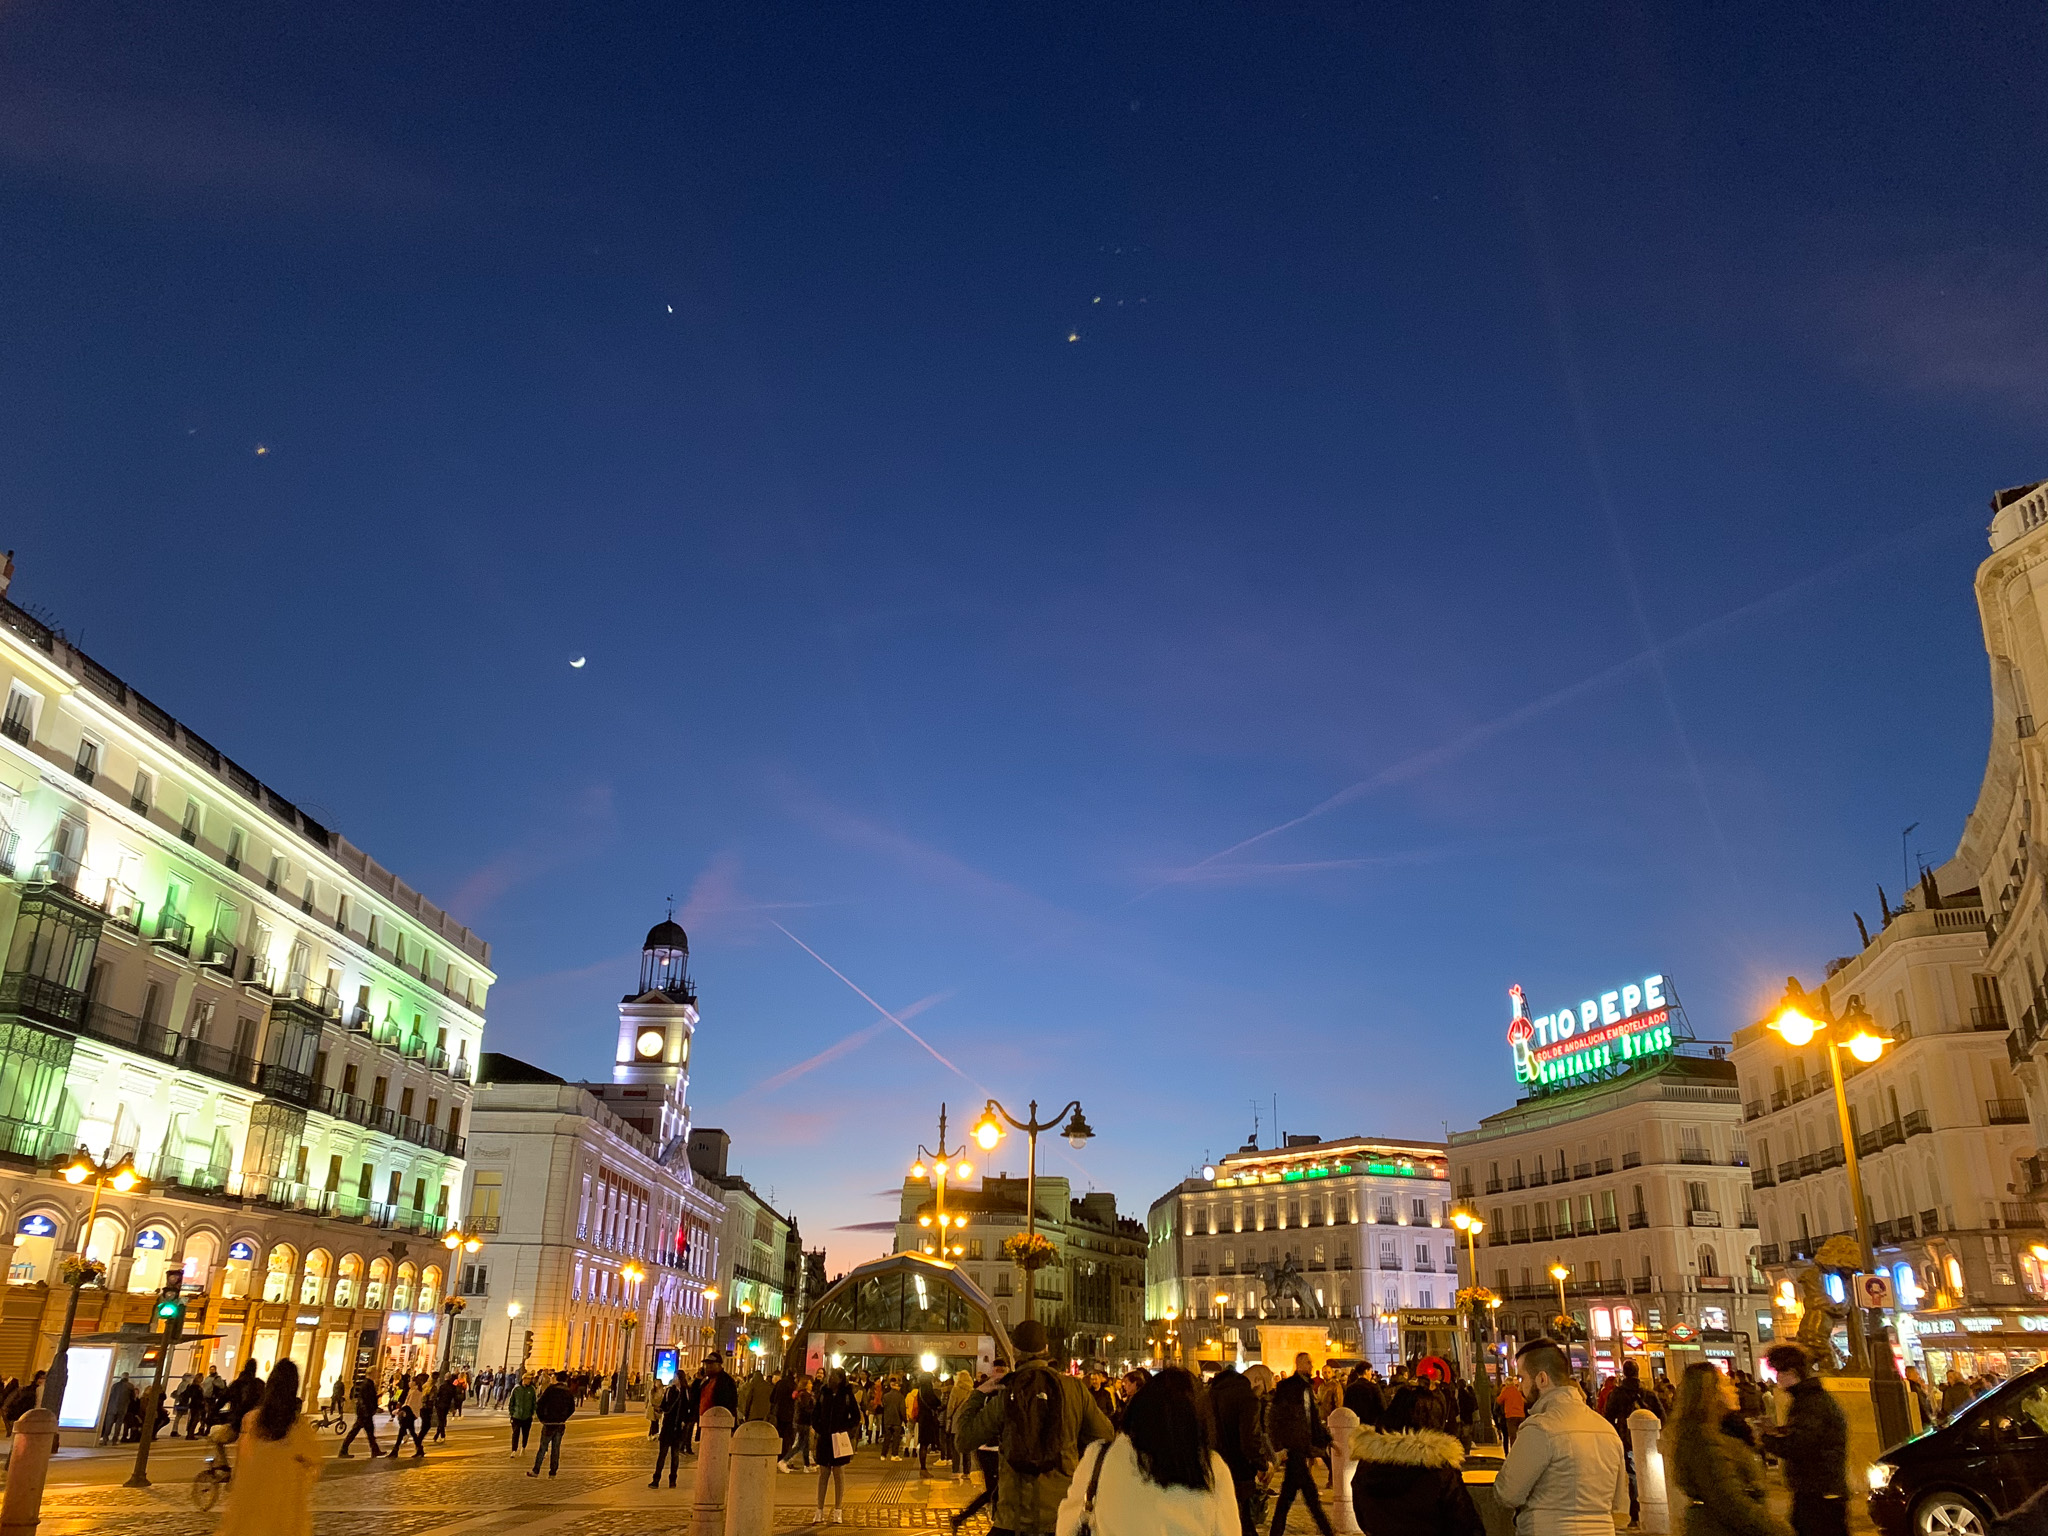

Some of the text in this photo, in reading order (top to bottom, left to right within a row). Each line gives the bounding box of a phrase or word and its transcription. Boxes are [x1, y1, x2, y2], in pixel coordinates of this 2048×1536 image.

[1533, 974, 1666, 1046] TIO PEPE
[1537, 1012, 1667, 1061] SOL DE ANDALUCIA EMBOTELLADO
[1620, 1026, 1673, 1060] BYASS
[1705, 1349, 1736, 1357] SEPHORA
